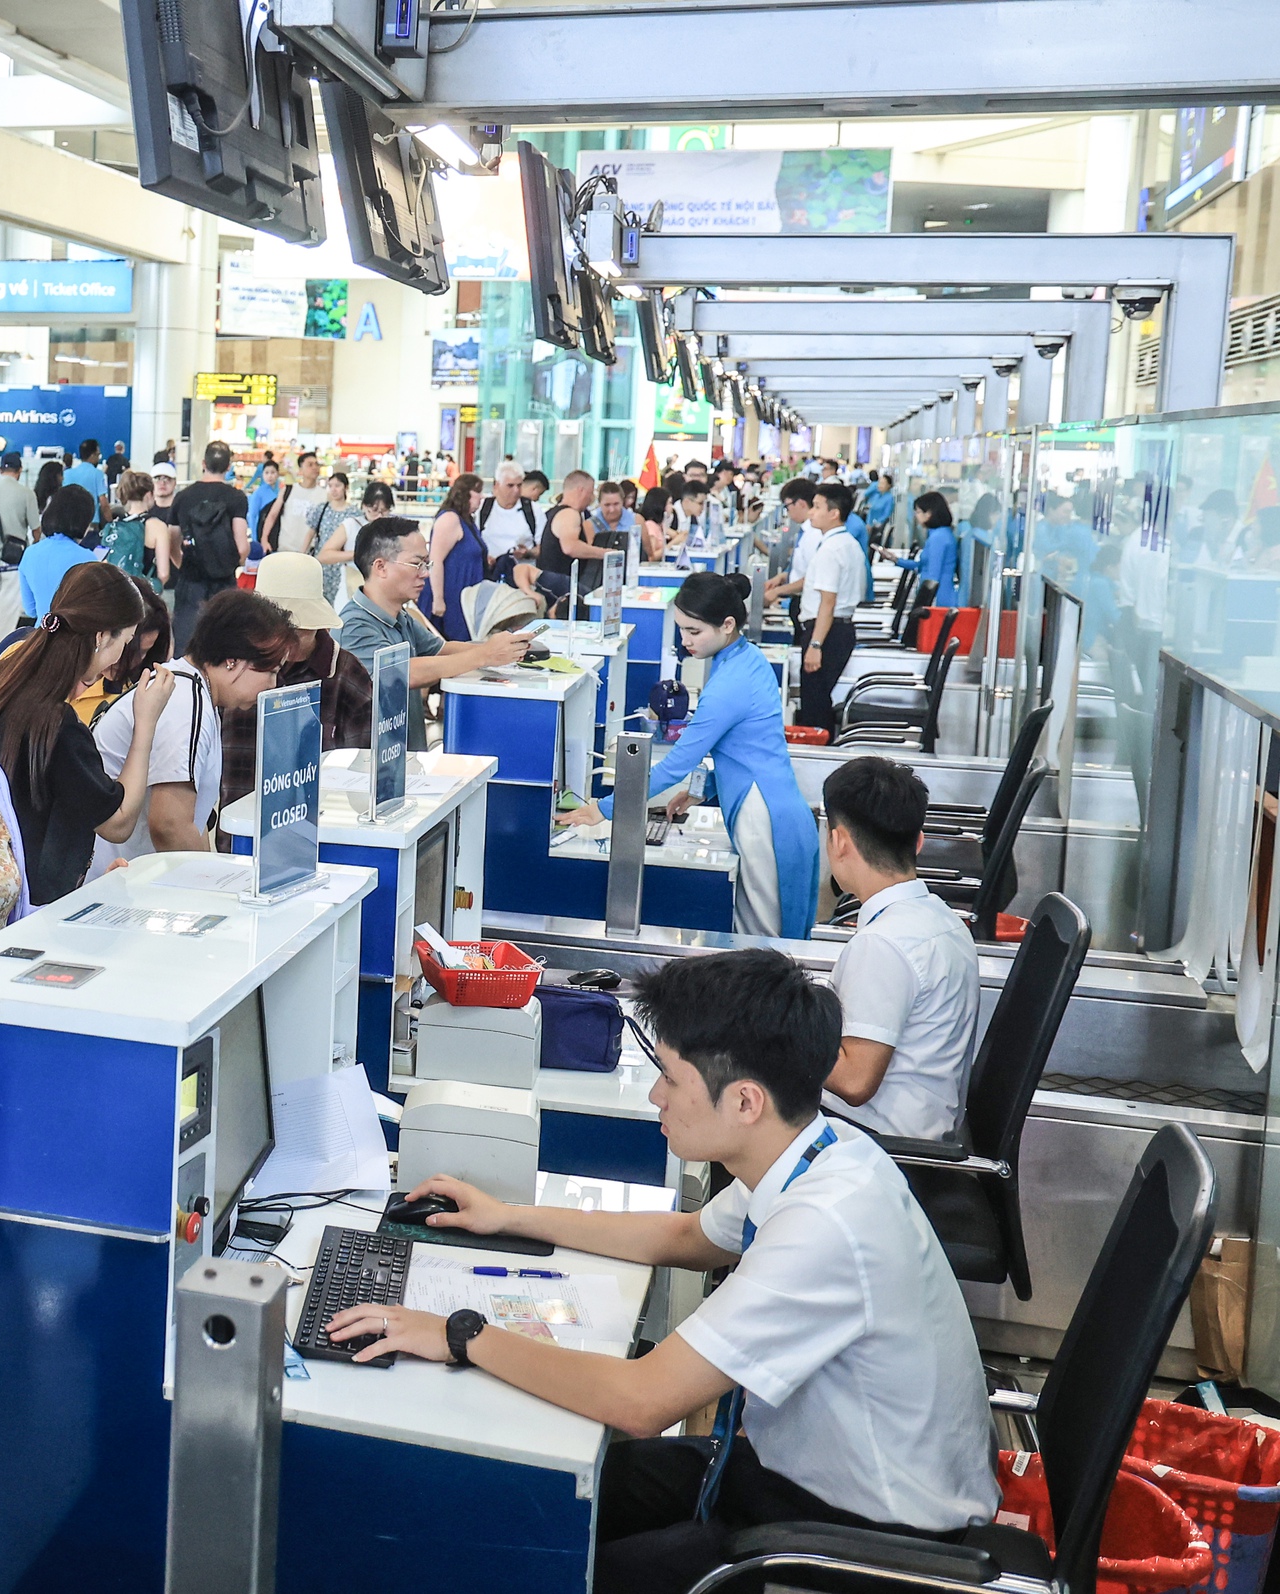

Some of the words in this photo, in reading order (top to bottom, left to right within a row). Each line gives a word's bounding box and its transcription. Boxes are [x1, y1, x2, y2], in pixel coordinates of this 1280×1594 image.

[590, 164, 621, 176] ACV
[9, 278, 28, 296] vé
[42, 282, 77, 296] Ticket
[79, 282, 115, 296] Office
[354, 302, 382, 341] A
[15, 409, 58, 424] Airlines
[378, 717, 393, 736] ĐÓNG
[381, 743, 401, 763] CLOSED
[263, 773, 291, 796] ĐÓNG
[293, 762, 317, 788] QUẦY
[271, 803, 308, 830] CLOSED
